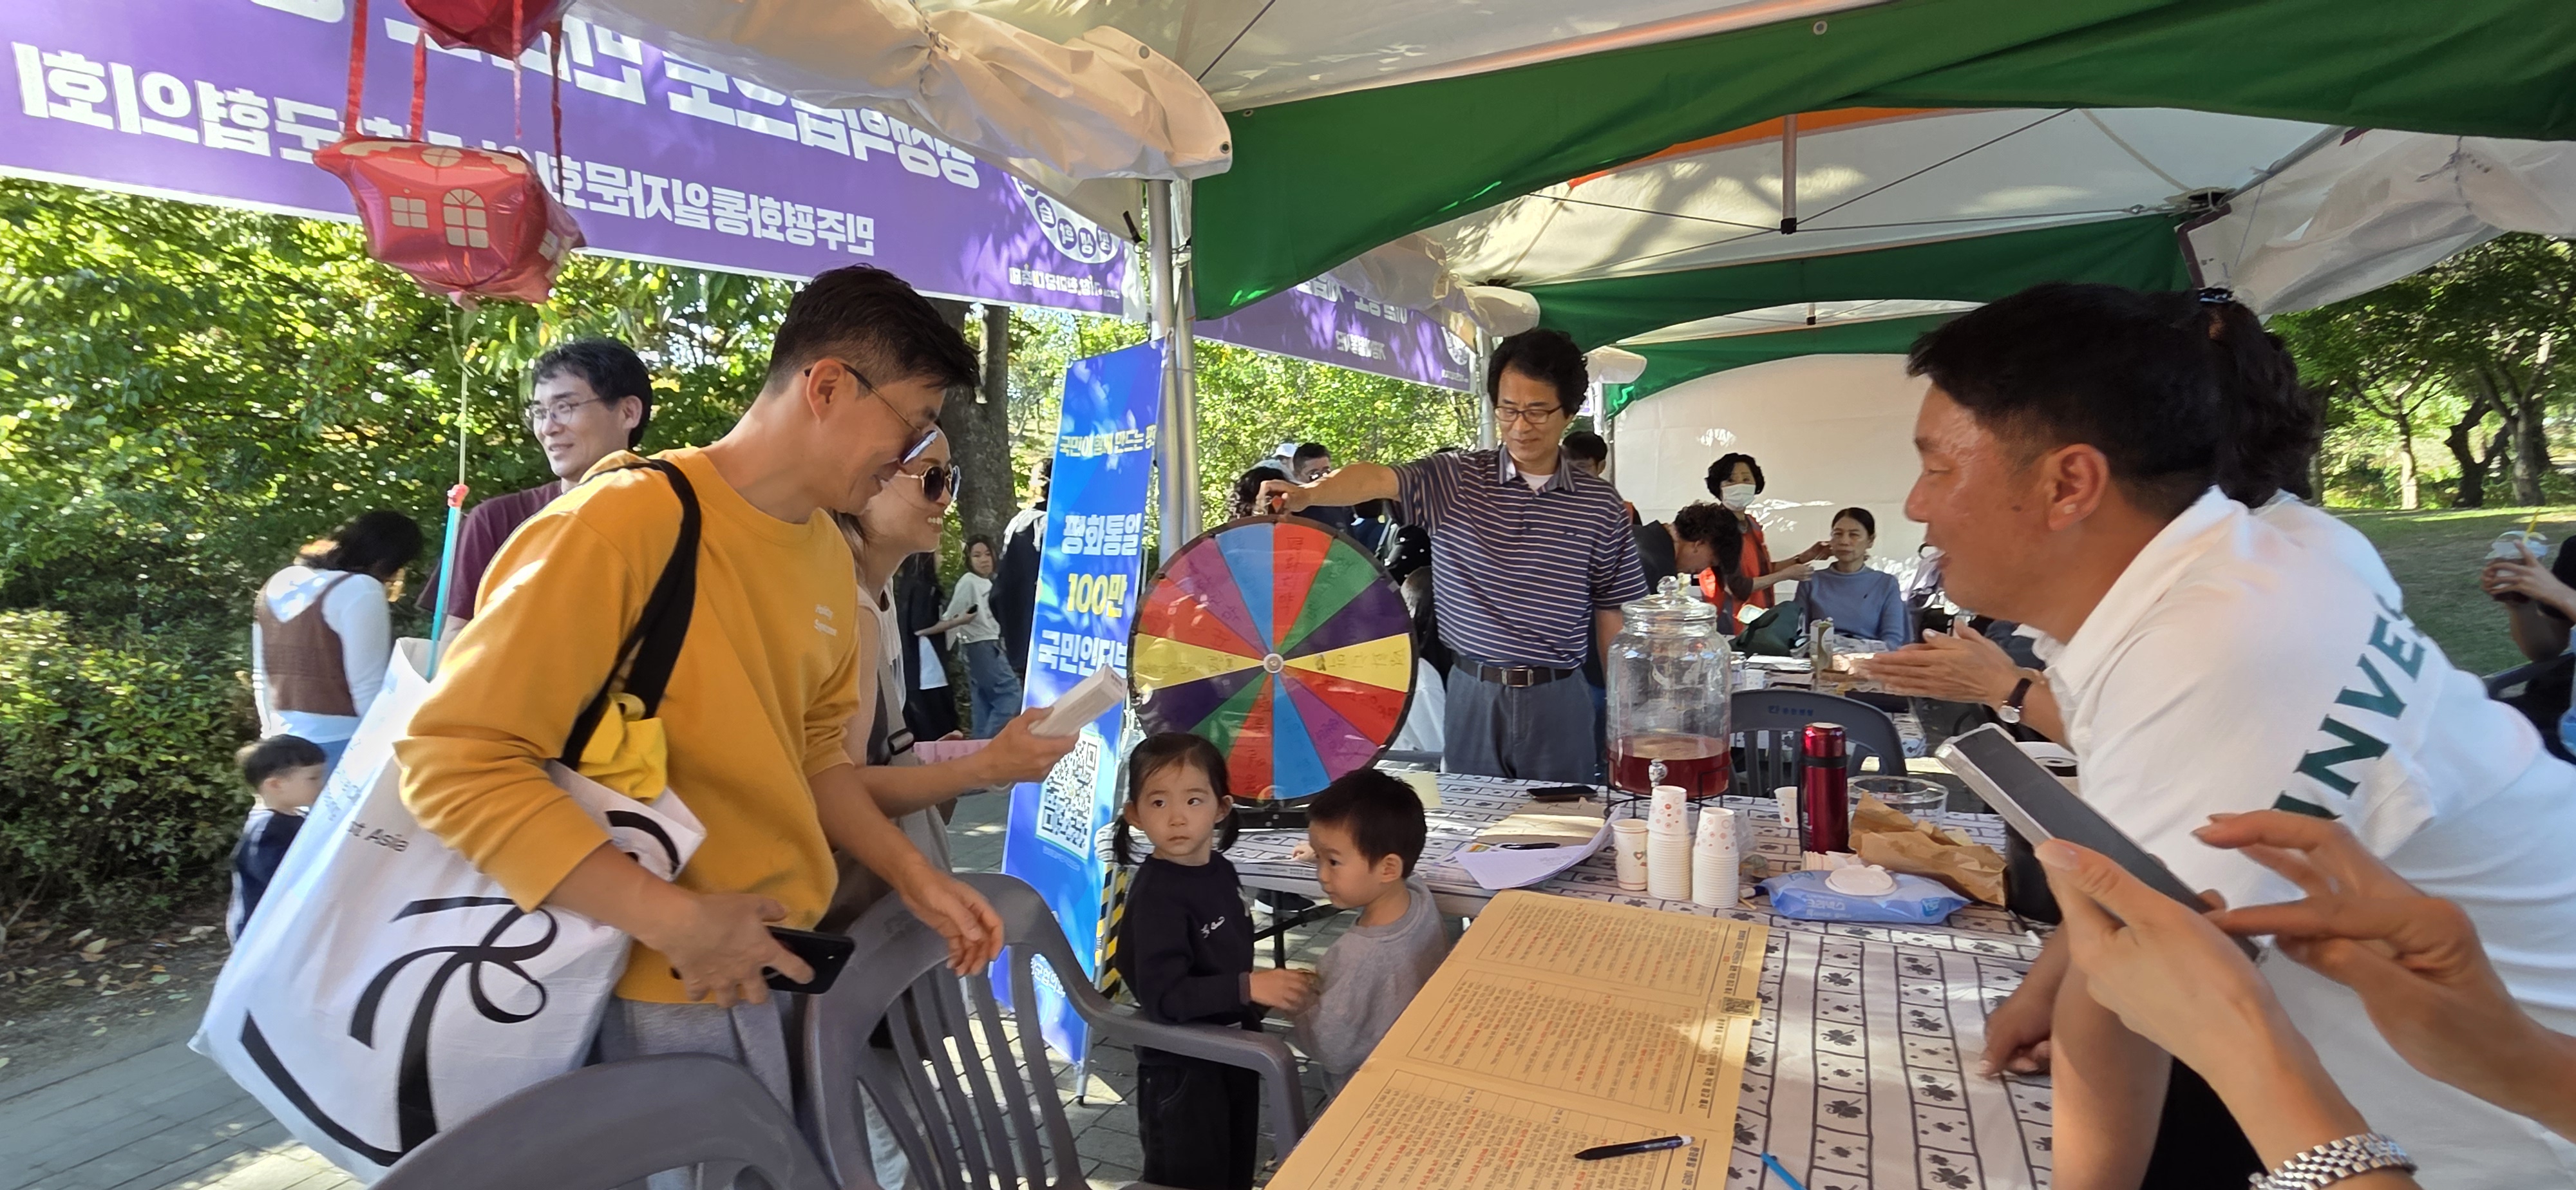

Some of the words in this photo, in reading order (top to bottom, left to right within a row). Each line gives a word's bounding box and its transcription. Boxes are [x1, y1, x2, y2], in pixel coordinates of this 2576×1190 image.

[1114, 429, 1144, 455] 만드는
[1061, 513, 1142, 556] 평화통일
[1066, 573, 1128, 618] 100만
[365, 828, 409, 853] Asia
